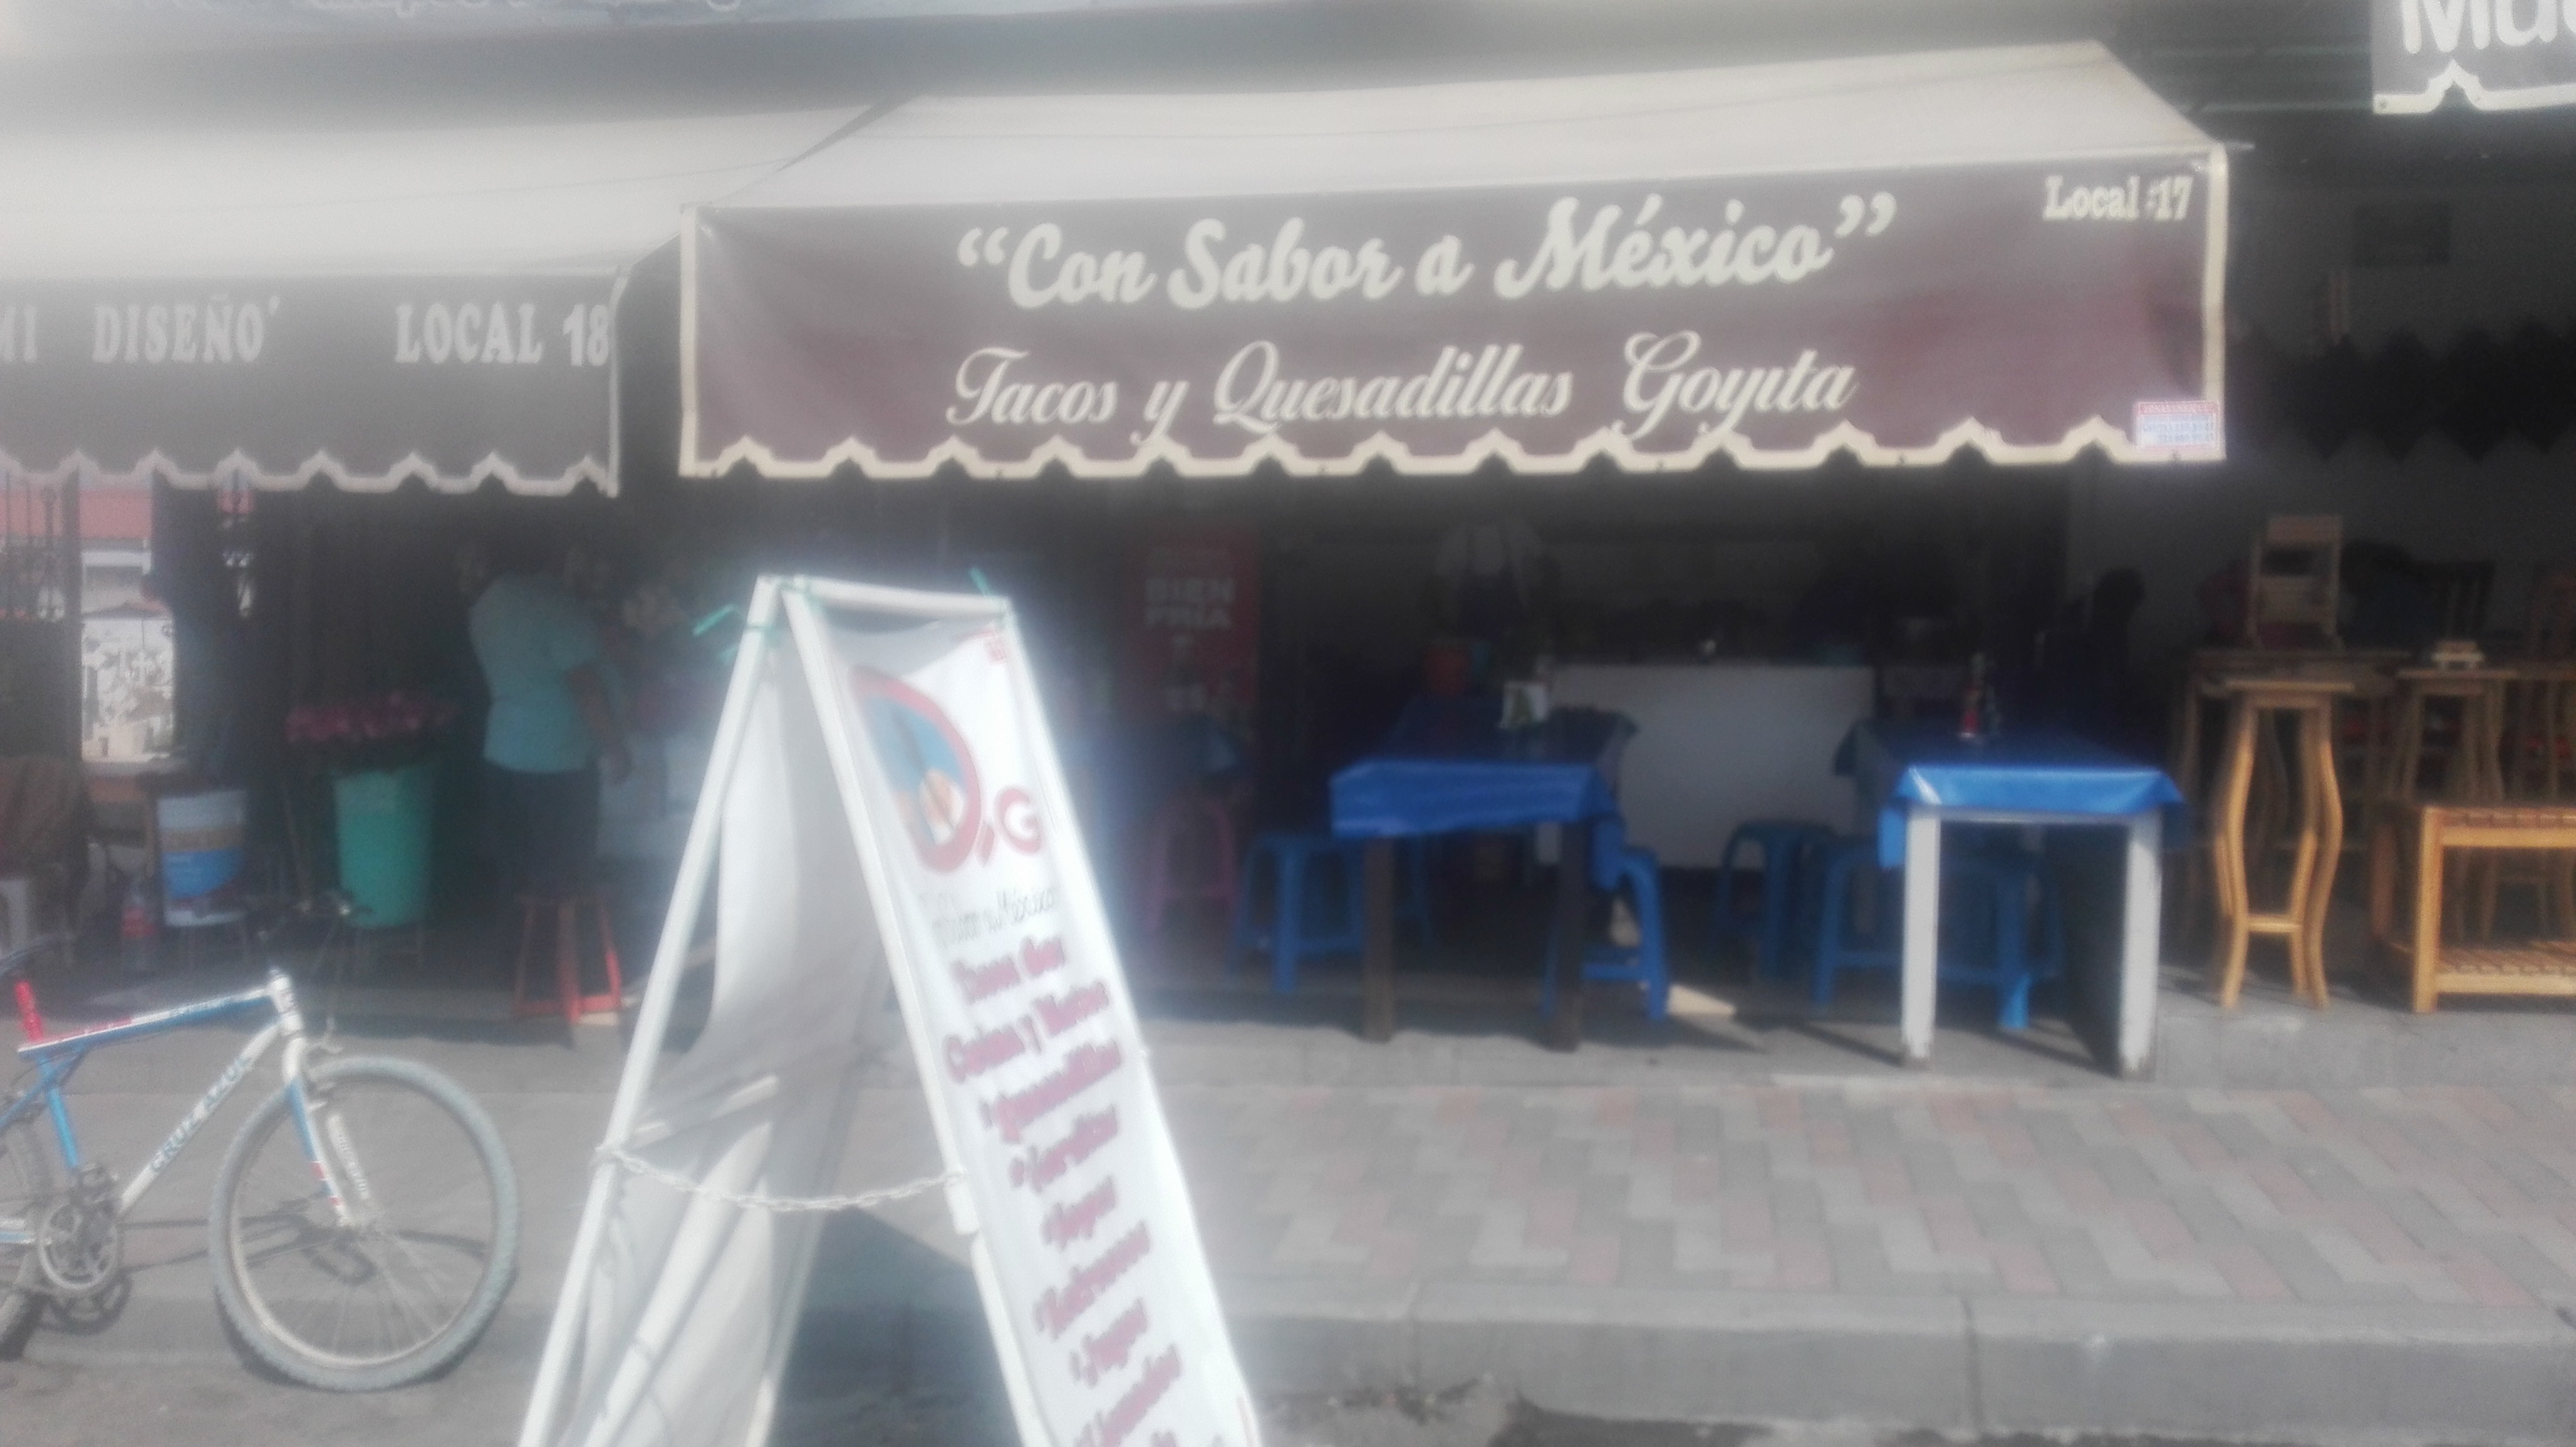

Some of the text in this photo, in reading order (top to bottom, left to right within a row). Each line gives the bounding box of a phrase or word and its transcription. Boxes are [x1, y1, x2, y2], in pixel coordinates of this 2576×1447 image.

[2043, 173, 2139, 221] Local
[1167, 216, 1404, 310] Sabor
[1414, 234, 1475, 296] a
[394, 302, 610, 367] LOCAL 18
[946, 346, 1118, 426] Tacos
[1129, 379, 1190, 448] y
[1212, 339, 1573, 435] Quesadillas
